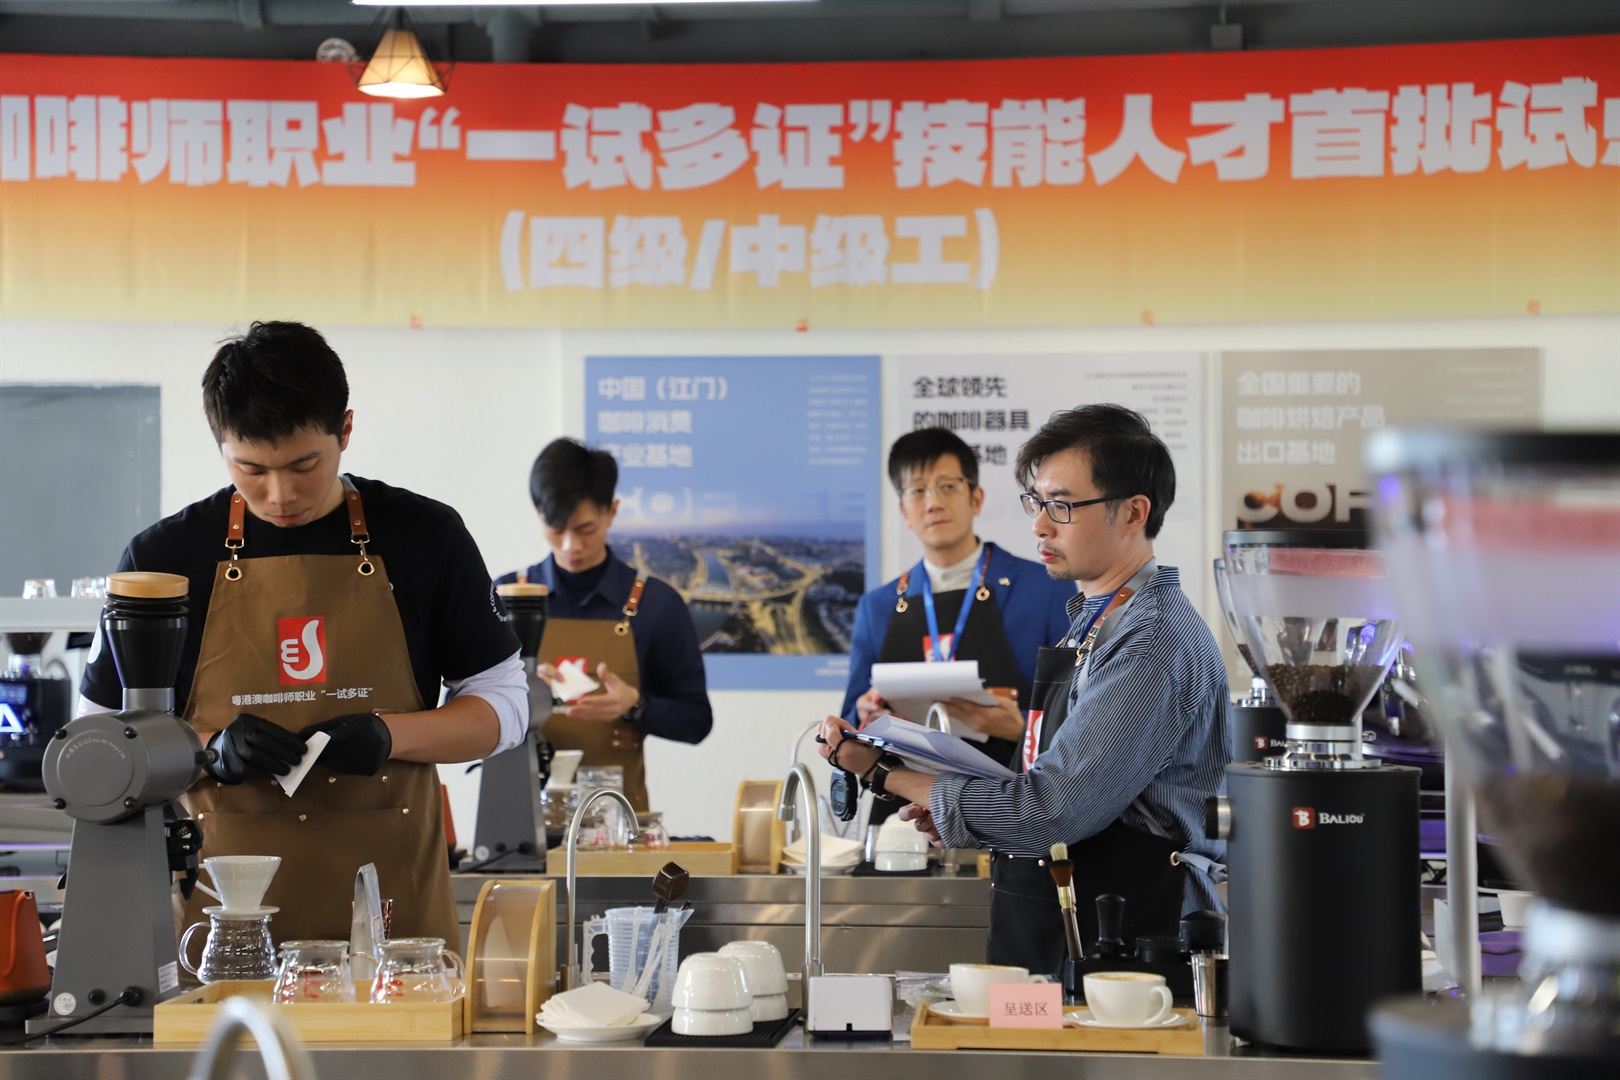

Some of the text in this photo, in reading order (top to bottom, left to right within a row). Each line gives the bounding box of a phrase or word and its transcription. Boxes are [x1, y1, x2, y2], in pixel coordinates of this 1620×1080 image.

[0, 76, 1620, 190] 啡师职业“一试多证”技能人才首批试
[912, 376, 1007, 399] 全球领先
[1237, 370, 1361, 396] 全国重要的
[598, 409, 693, 434] 咖啡消费
[912, 409, 1029, 432] 的咖啡器具
[1237, 405, 1386, 430] 咖啡烘焙产品
[1237, 439, 1336, 465] 出口基地
[1003, 1001, 1049, 1017] 呈送区
